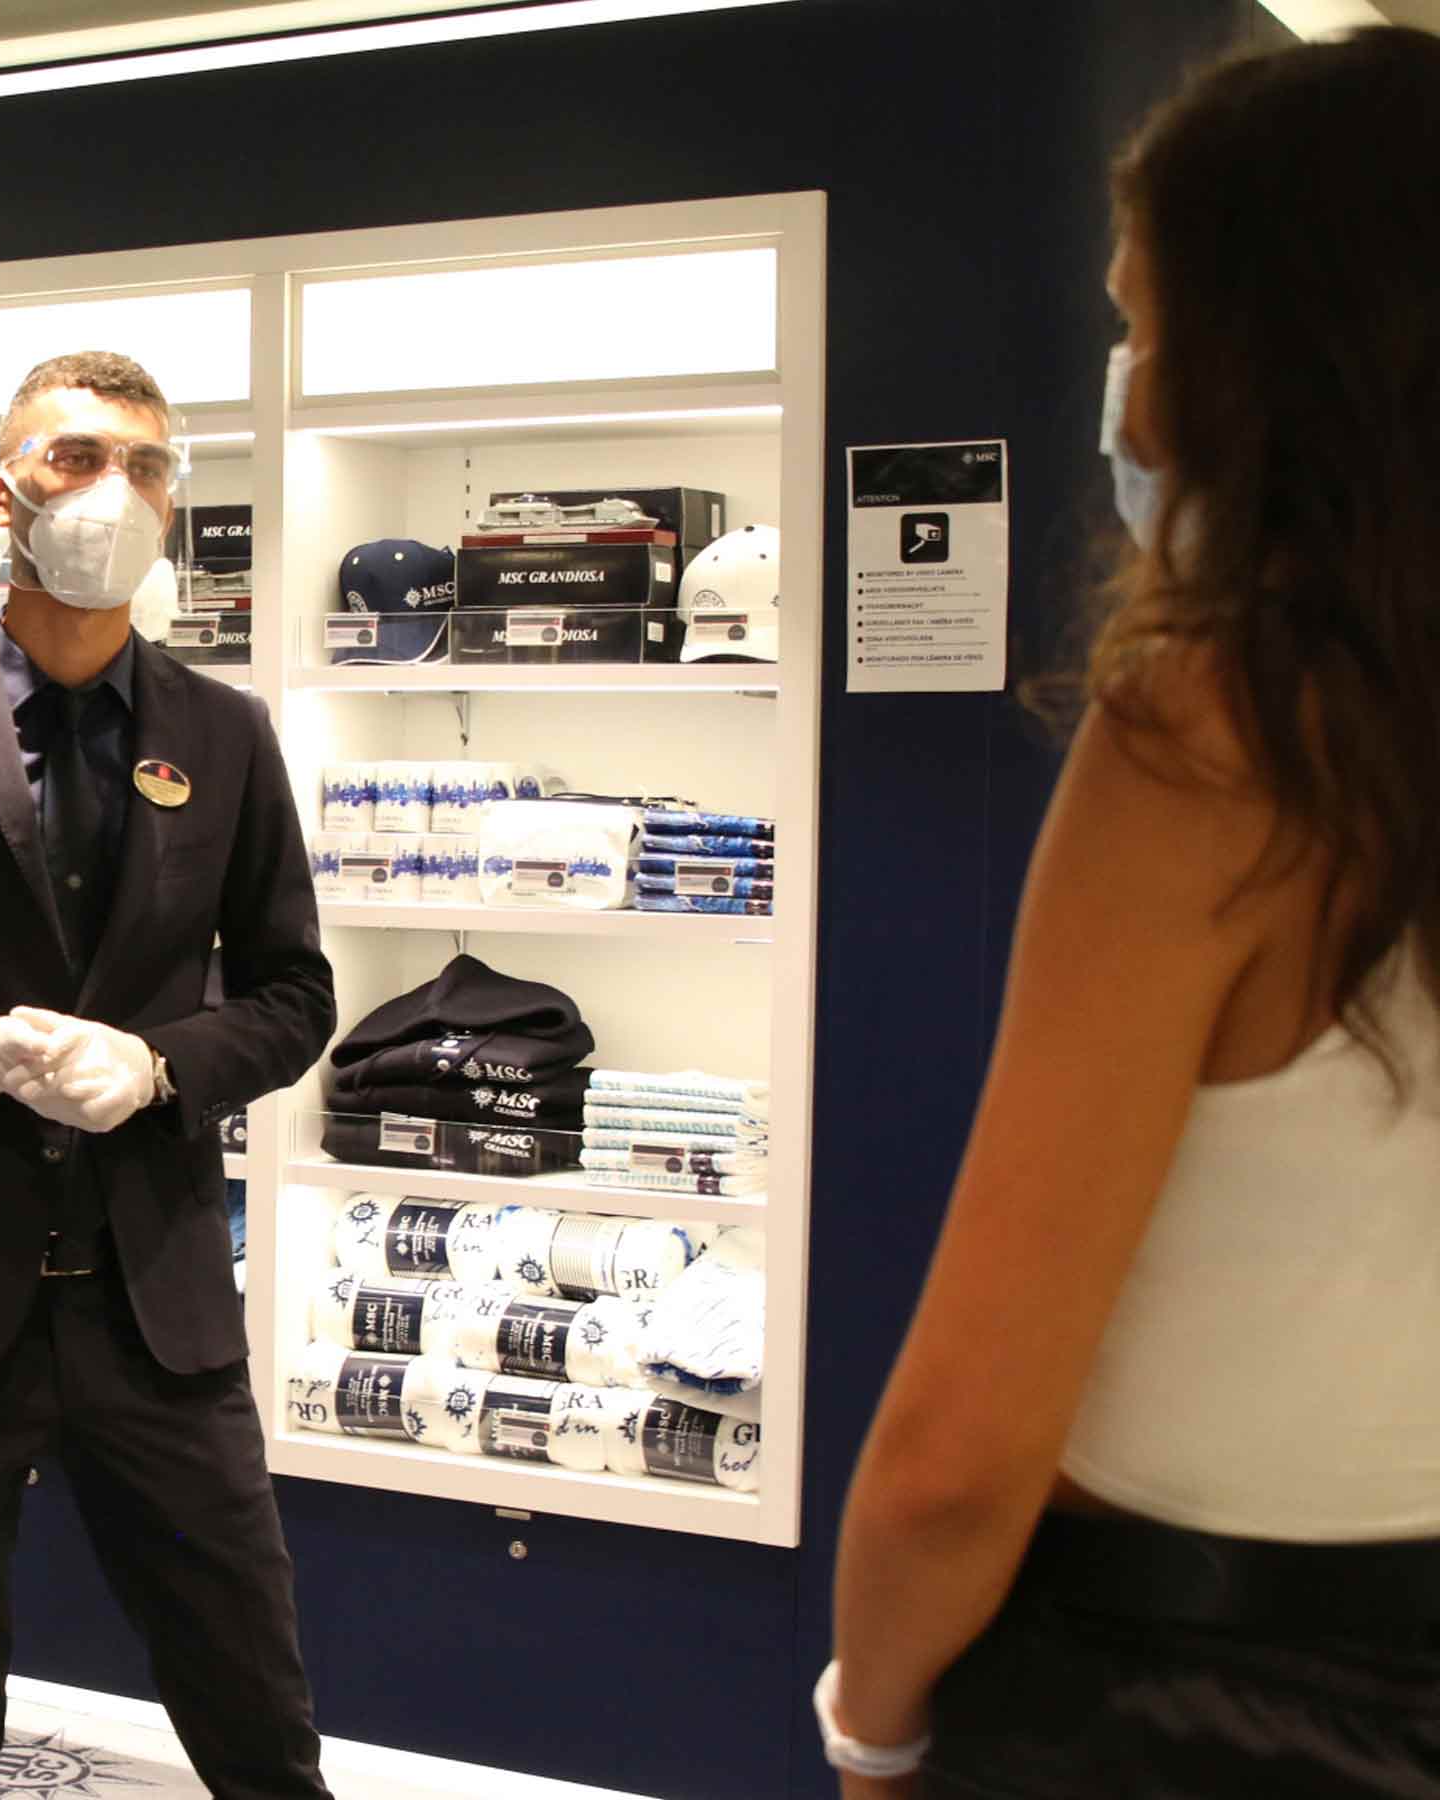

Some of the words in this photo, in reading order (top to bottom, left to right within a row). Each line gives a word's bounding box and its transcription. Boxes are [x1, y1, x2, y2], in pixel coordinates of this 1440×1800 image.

[201, 526, 226, 538] MSC
[498, 571, 527, 584] MSC
[529, 570, 605, 583] GRANDIOSA
[422, 581, 455, 600] MSC
[484, 1063, 533, 1081] MSC
[496, 1089, 540, 1110] MSC
[488, 1132, 535, 1149] MSC
